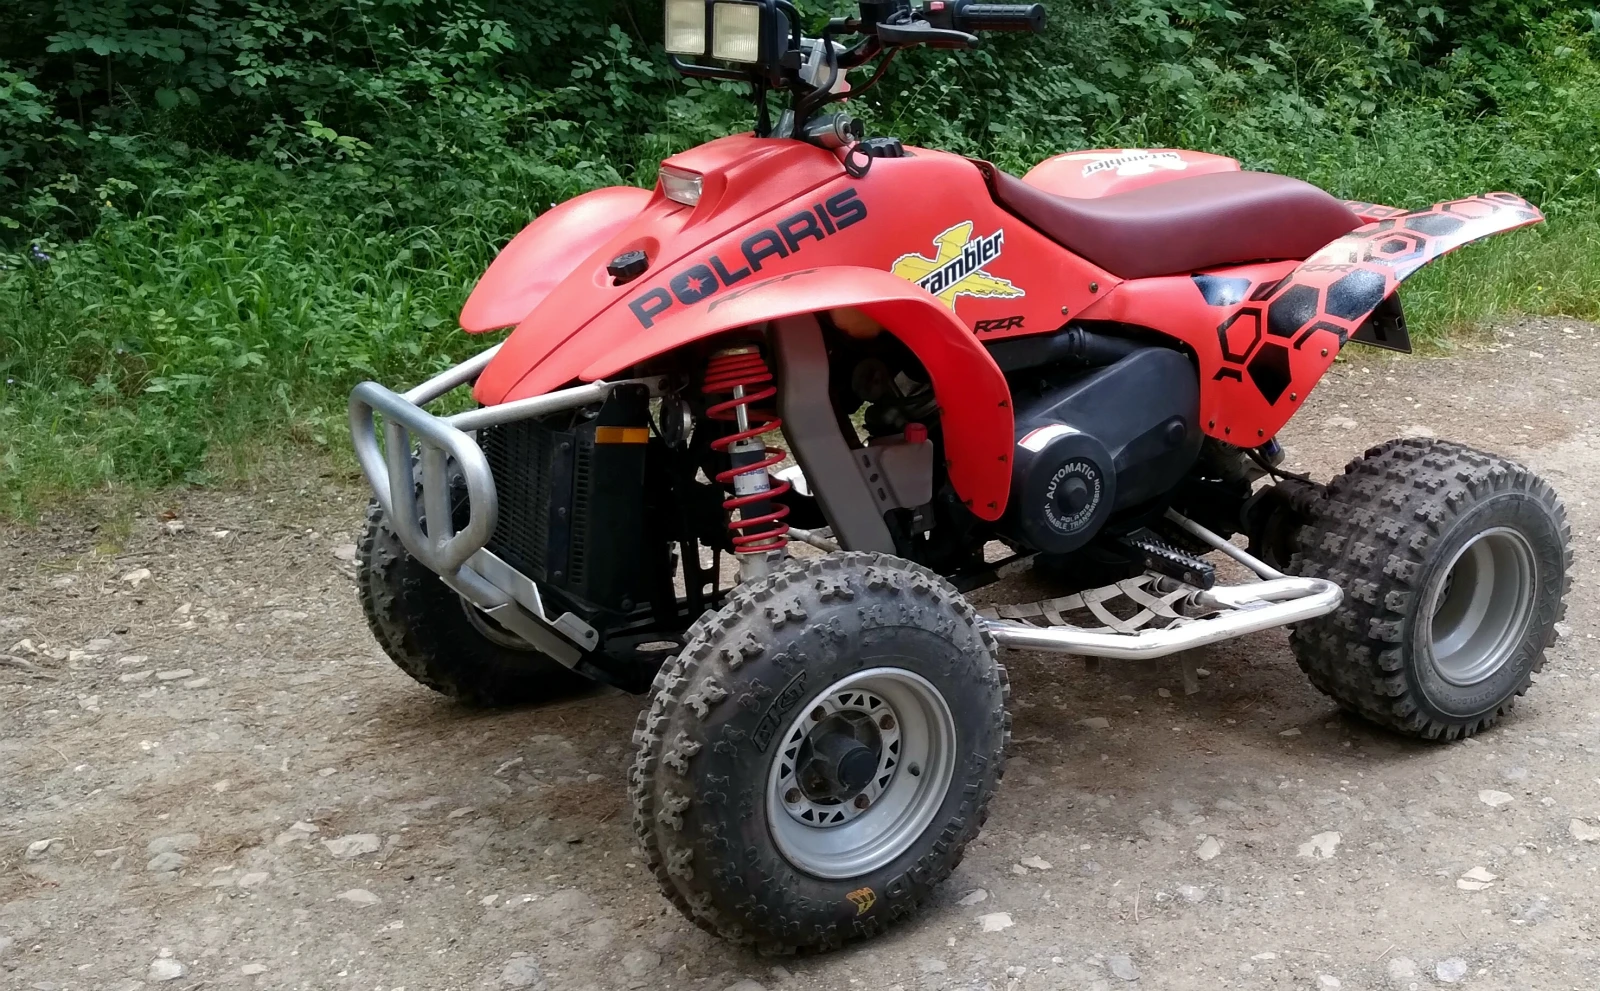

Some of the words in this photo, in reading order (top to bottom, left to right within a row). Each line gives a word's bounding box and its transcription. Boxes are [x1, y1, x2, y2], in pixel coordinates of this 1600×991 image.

[628, 187, 868, 329] POLARIS
[917, 230, 1003, 295] rambler
[973, 315, 1025, 335] RZR
[1046, 462, 1095, 500] AUTOMATIC
[1044, 502, 1068, 530] VARIABLE
[1069, 478, 1101, 529] TRANSMISSION
[1060, 503, 1090, 522] POLARIS
